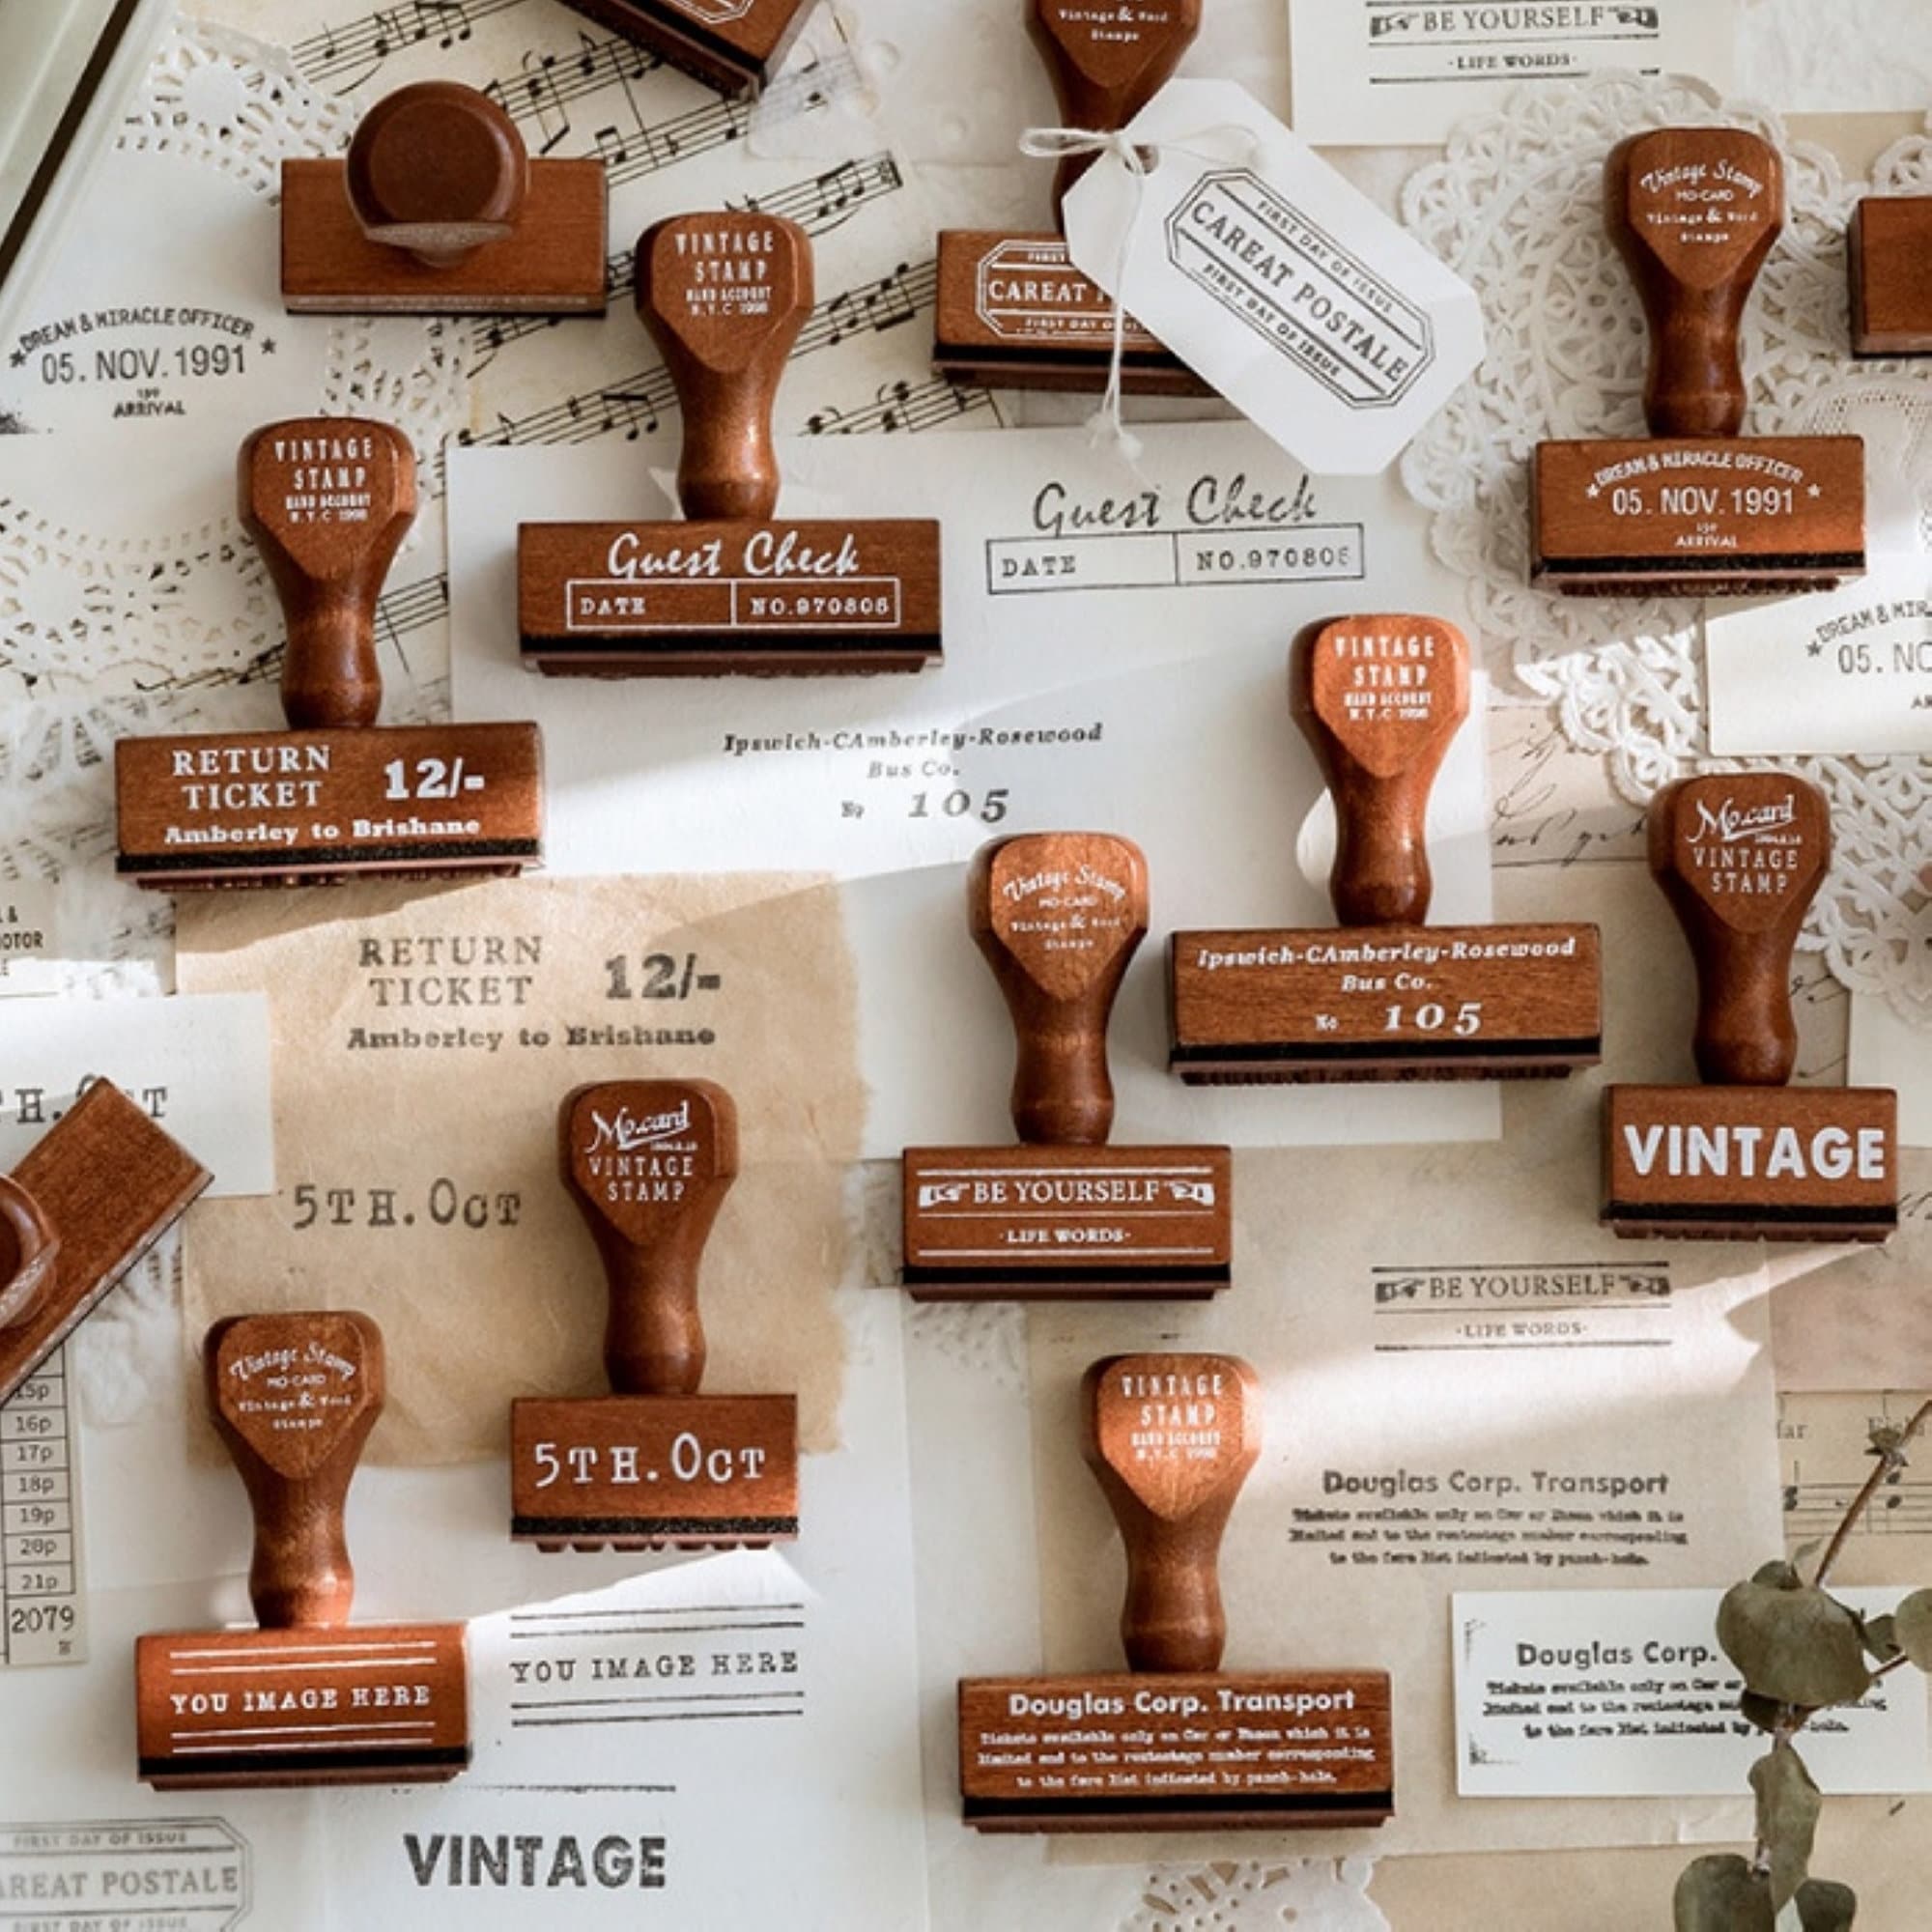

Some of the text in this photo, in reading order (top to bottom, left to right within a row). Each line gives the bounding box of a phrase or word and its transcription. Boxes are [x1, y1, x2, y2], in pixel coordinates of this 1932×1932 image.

[1424, 7, 1604, 33] BE YOURSELF
[675, 231, 774, 256] VINTAGE
[1257, 200, 1297, 236] FIRST
[1299, 234, 1327, 261] DAY
[1330, 259, 1350, 278] OF
[696, 258, 768, 283] STAMP
[988, 280, 1088, 302] CAREAT
[1192, 200, 1408, 383] CAREAT POSTALE
[1204, 263, 1243, 298] FIRST
[1247, 296, 1275, 324] DAY
[1277, 322, 1298, 341] OF
[79, 312, 94, 332] &
[95, 307, 176, 327] MIRACLE
[178, 308, 255, 338] OFFICER
[42, 353, 86, 384] 05.
[113, 400, 186, 418] ARRIVAL
[274, 437, 372, 463] VINTAGE
[294, 466, 366, 491] STAMP
[1033, 473, 1317, 537] Guest Check
[1612, 486, 1653, 516] 05.
[608, 530, 860, 580] Guest Check
[1002, 554, 1077, 578] DATE
[580, 597, 646, 615] DATE
[1335, 636, 1435, 658] VINTAGE
[1838, 644, 1884, 673] 05.
[1354, 664, 1428, 688] STAMP
[172, 744, 330, 777] RETURN
[867, 758, 960, 779] Bus Co.
[182, 780, 323, 810] TICKET
[164, 822, 298, 846] Amberley
[311, 823, 339, 840] to
[1693, 847, 1798, 870] VINTAGE
[1711, 871, 1787, 895] STAMP
[0, 930, 43, 951] OTOR
[357, 935, 544, 968] RETURN
[369, 975, 532, 1008] TICKET
[1341, 973, 1434, 992] Bus Co.
[347, 1026, 504, 1051] Amberley
[519, 1027, 551, 1046] to
[1623, 1124, 1886, 1179] VINTAGE
[589, 1156, 694, 1177] VINTAGE
[608, 1180, 685, 1202] STAMP
[974, 1179, 1160, 1204] BE YOURSELF
[1430, 1273, 1616, 1299] BE YOURSELF
[1122, 1374, 1222, 1398] VINTAGE
[15, 1415, 52, 1434] 16p
[1141, 1404, 1215, 1428] STAMP
[16, 1444, 53, 1462] 17p
[18, 1476, 55, 1494] 18p
[1323, 1468, 1669, 1498] Douglas Corp. Transport
[19, 1507, 55, 1526] 19p
[21, 1574, 58, 1590] 21p
[11, 1605, 75, 1634] 2079
[509, 1652, 798, 1684] YOU IMAGE HERE
[1517, 1641, 1718, 1671] Douglas Corp.
[170, 1685, 431, 1715] YOU IMAGE HERE
[1009, 1689, 1354, 1719] Douglas Corp. Transport
[13, 1834, 61, 1848] FIRST
[70, 1834, 100, 1846] DAY
[403, 1833, 667, 1889] VINTAGE
[102, 1866, 239, 1895] POSTALE
